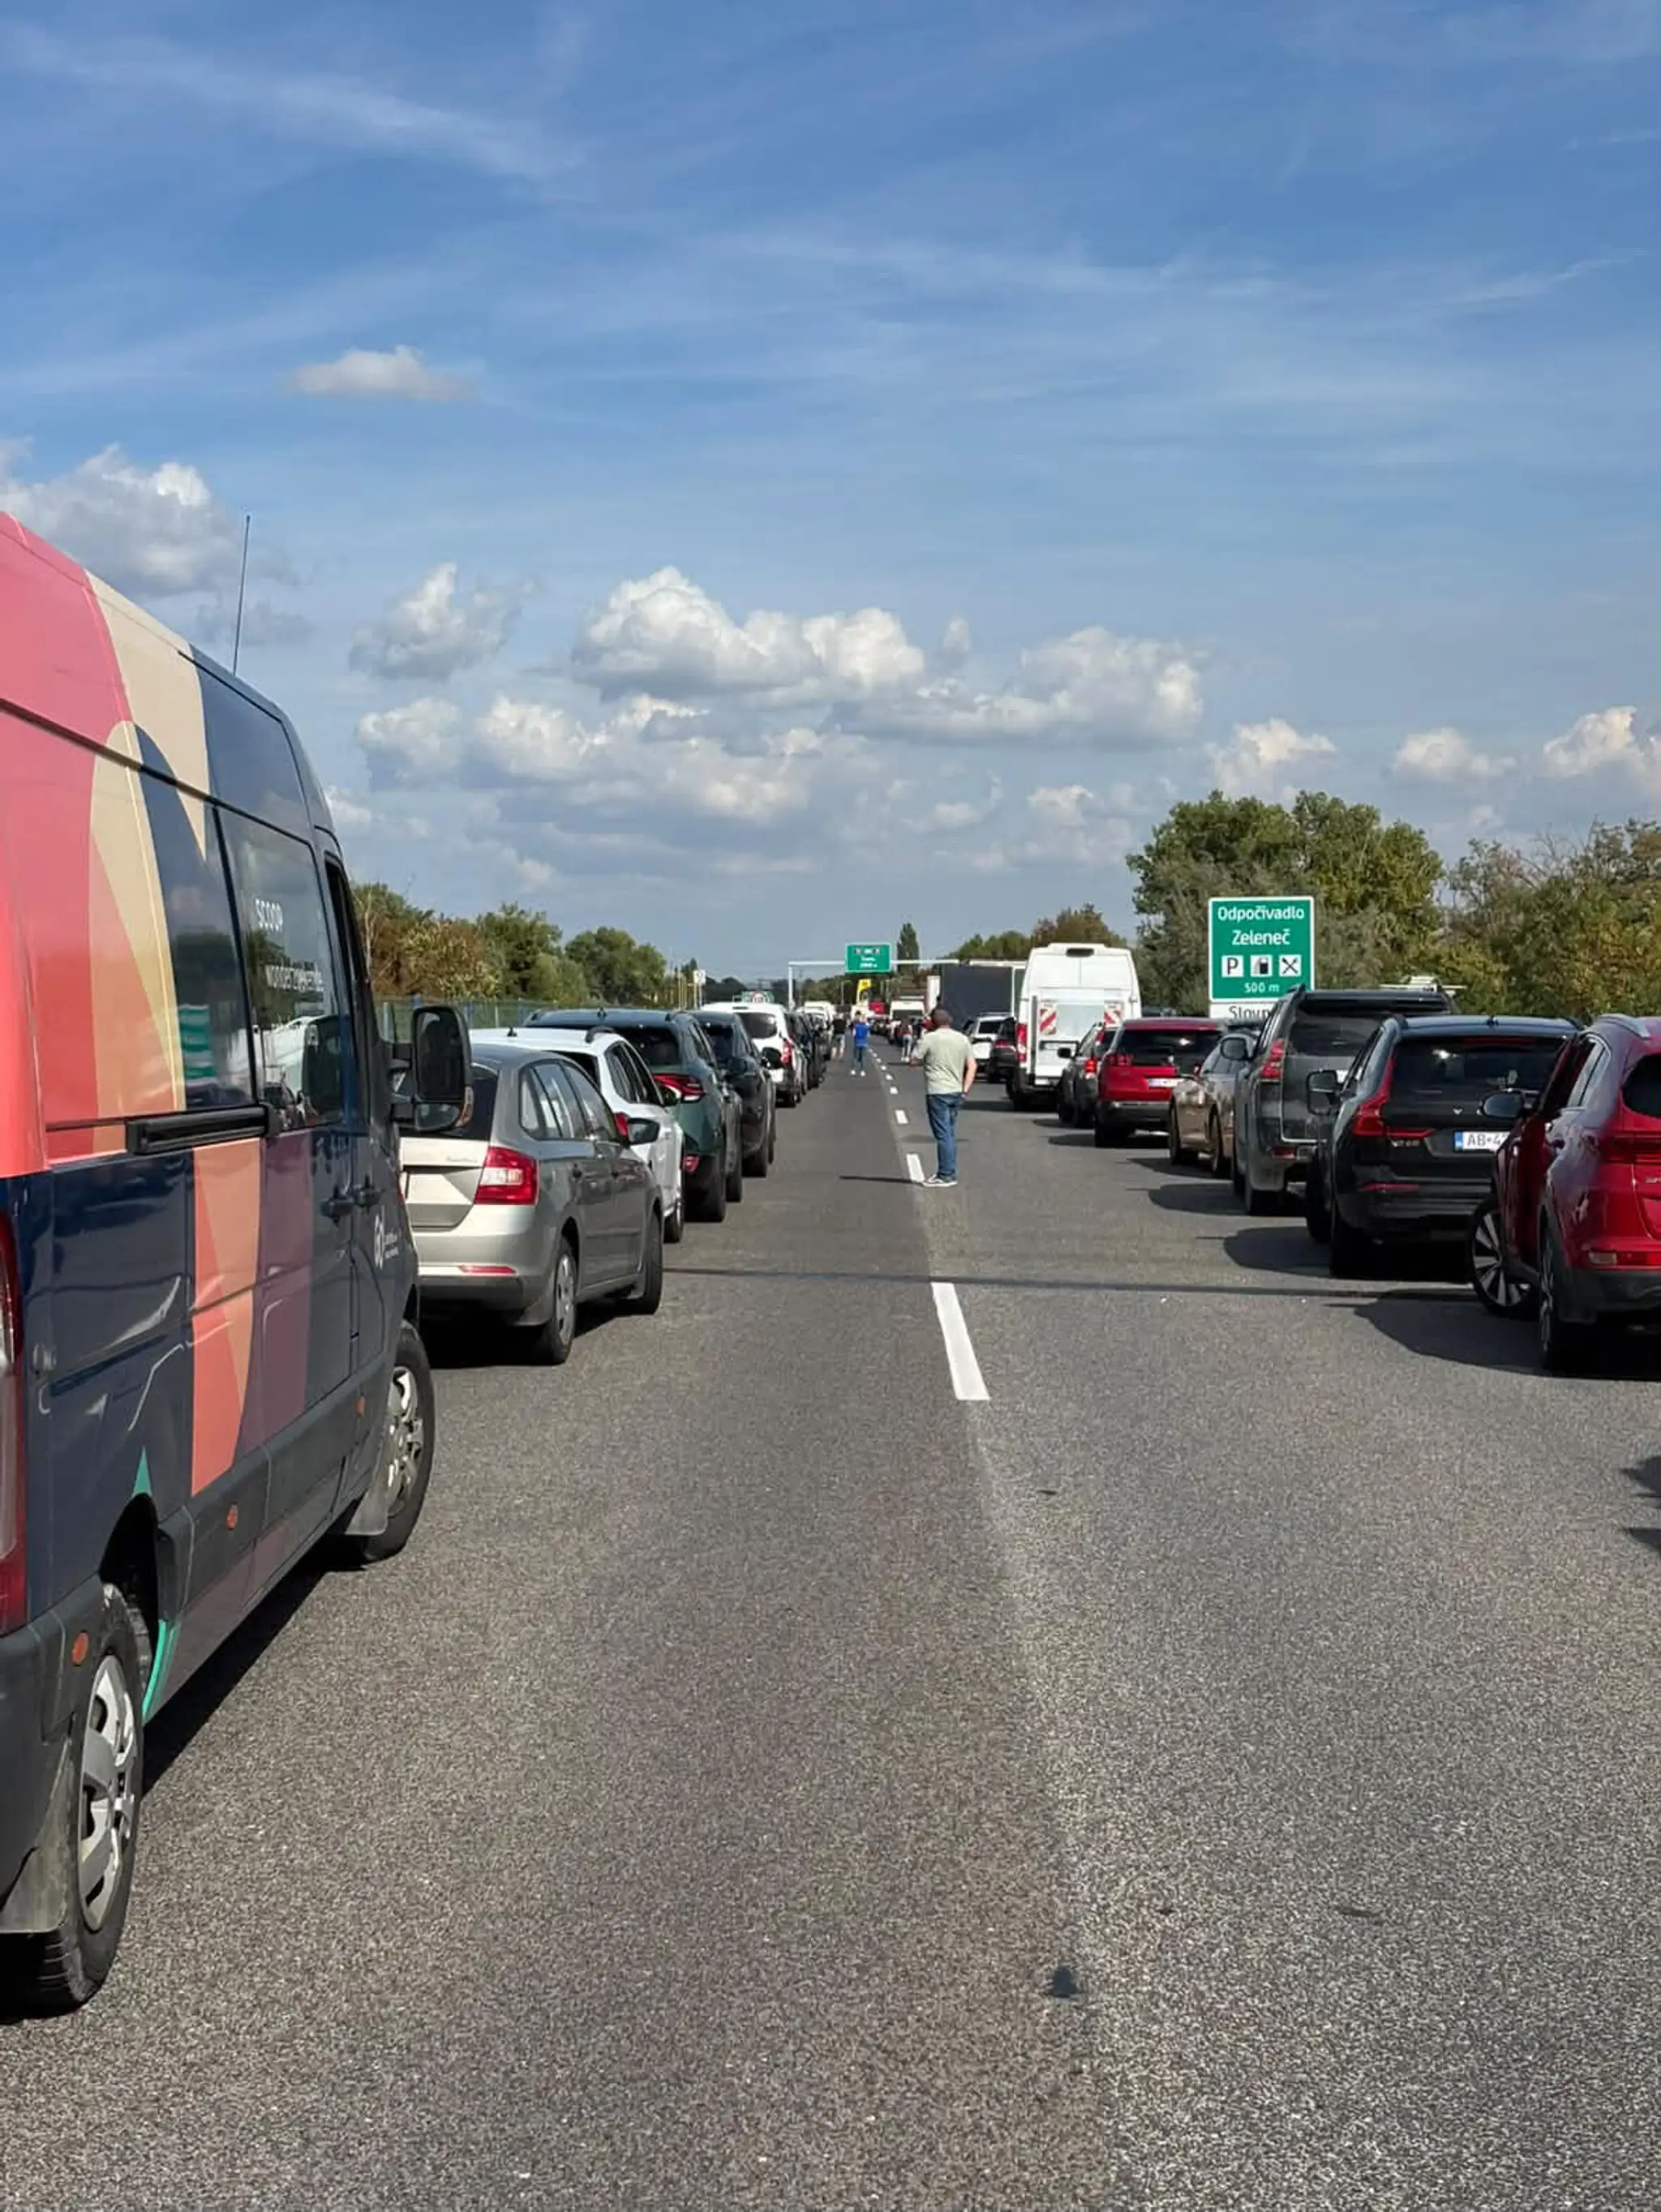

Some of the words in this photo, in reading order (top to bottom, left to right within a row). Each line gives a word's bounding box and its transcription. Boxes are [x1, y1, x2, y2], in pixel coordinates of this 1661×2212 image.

[1217, 906, 1305, 923] Odpočívadlo
[1231, 928, 1290, 945] Zeleneč
[1226, 957, 1238, 975] P
[1244, 982, 1266, 993] 500
[1268, 984, 1280, 992] m
